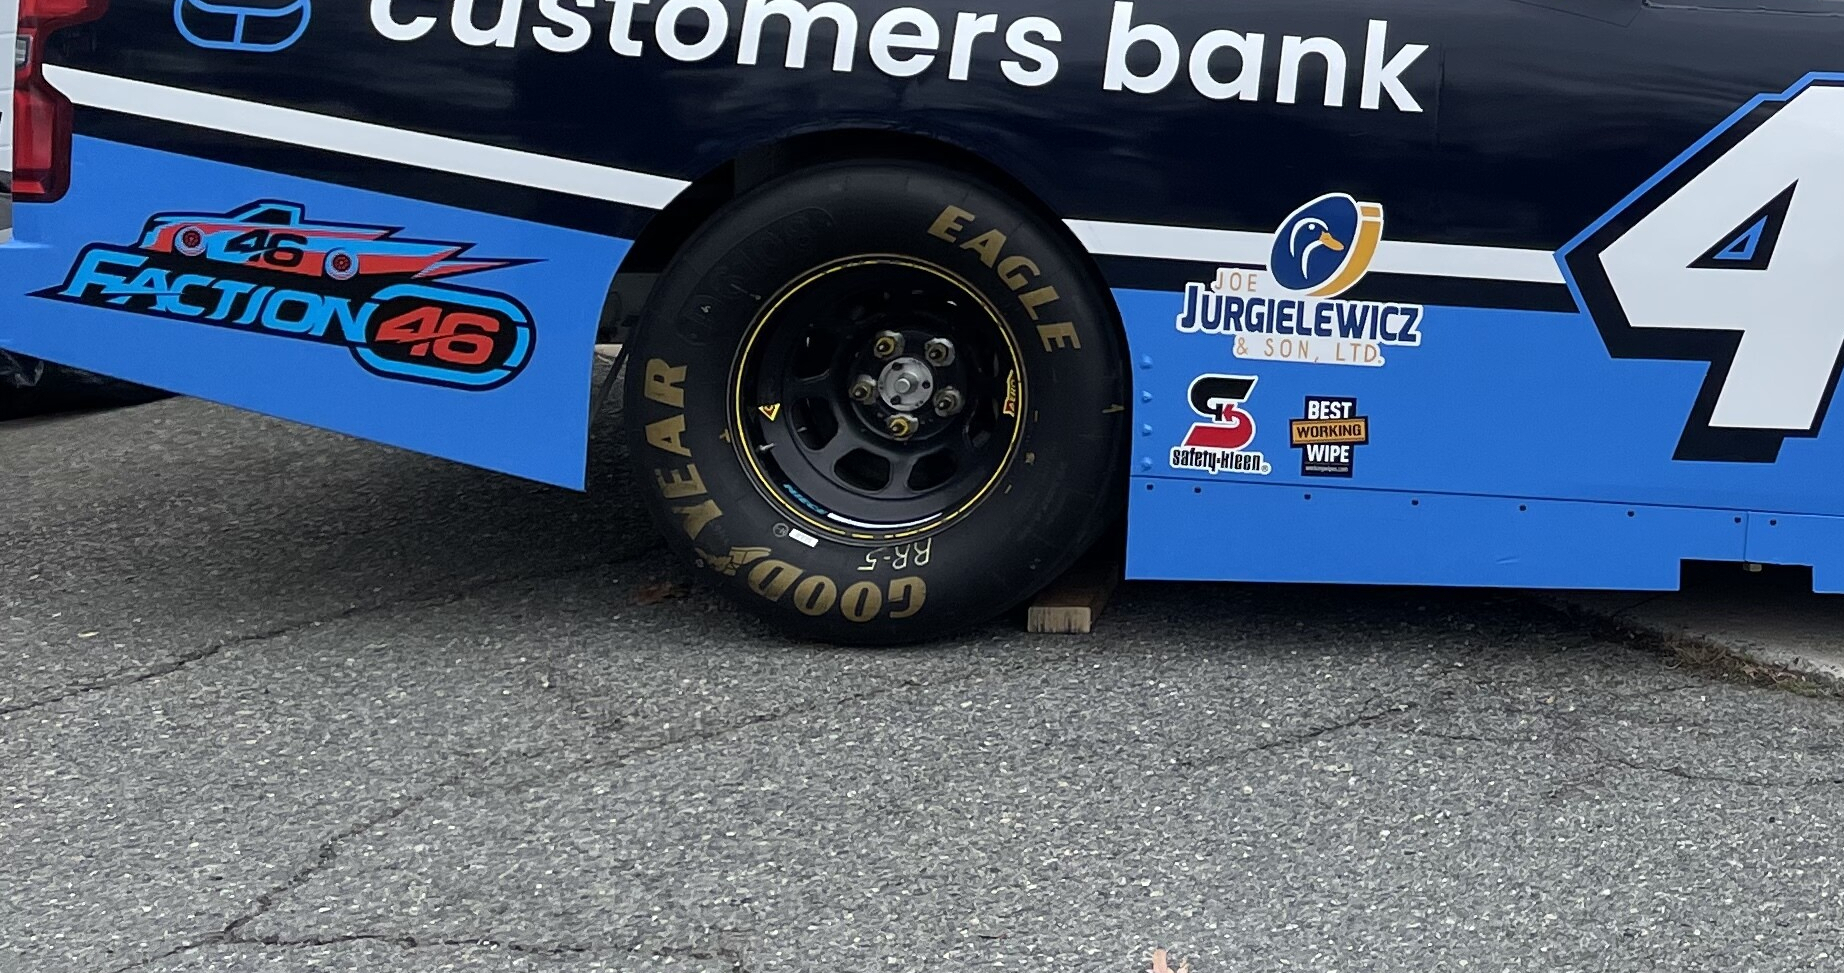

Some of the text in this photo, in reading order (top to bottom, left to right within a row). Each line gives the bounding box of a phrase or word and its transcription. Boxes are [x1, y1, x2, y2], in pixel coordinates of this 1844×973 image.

[1102, 0, 1429, 114] bank
[225, 227, 309, 269] 46
[927, 204, 1081, 353] EAGLE
[1214, 271, 1259, 293] JOE
[58, 249, 501, 366] FACTION 46
[1181, 285, 1420, 343] JURGIELEWICZ
[1236, 337, 1383, 365] & SON, LTD.
[1308, 400, 1352, 420] BEST
[1296, 424, 1362, 439] WORKING
[1306, 444, 1350, 463] WIPE
[644, 357, 928, 623] GOODYEAR
[856, 537, 932, 571] RR-5
